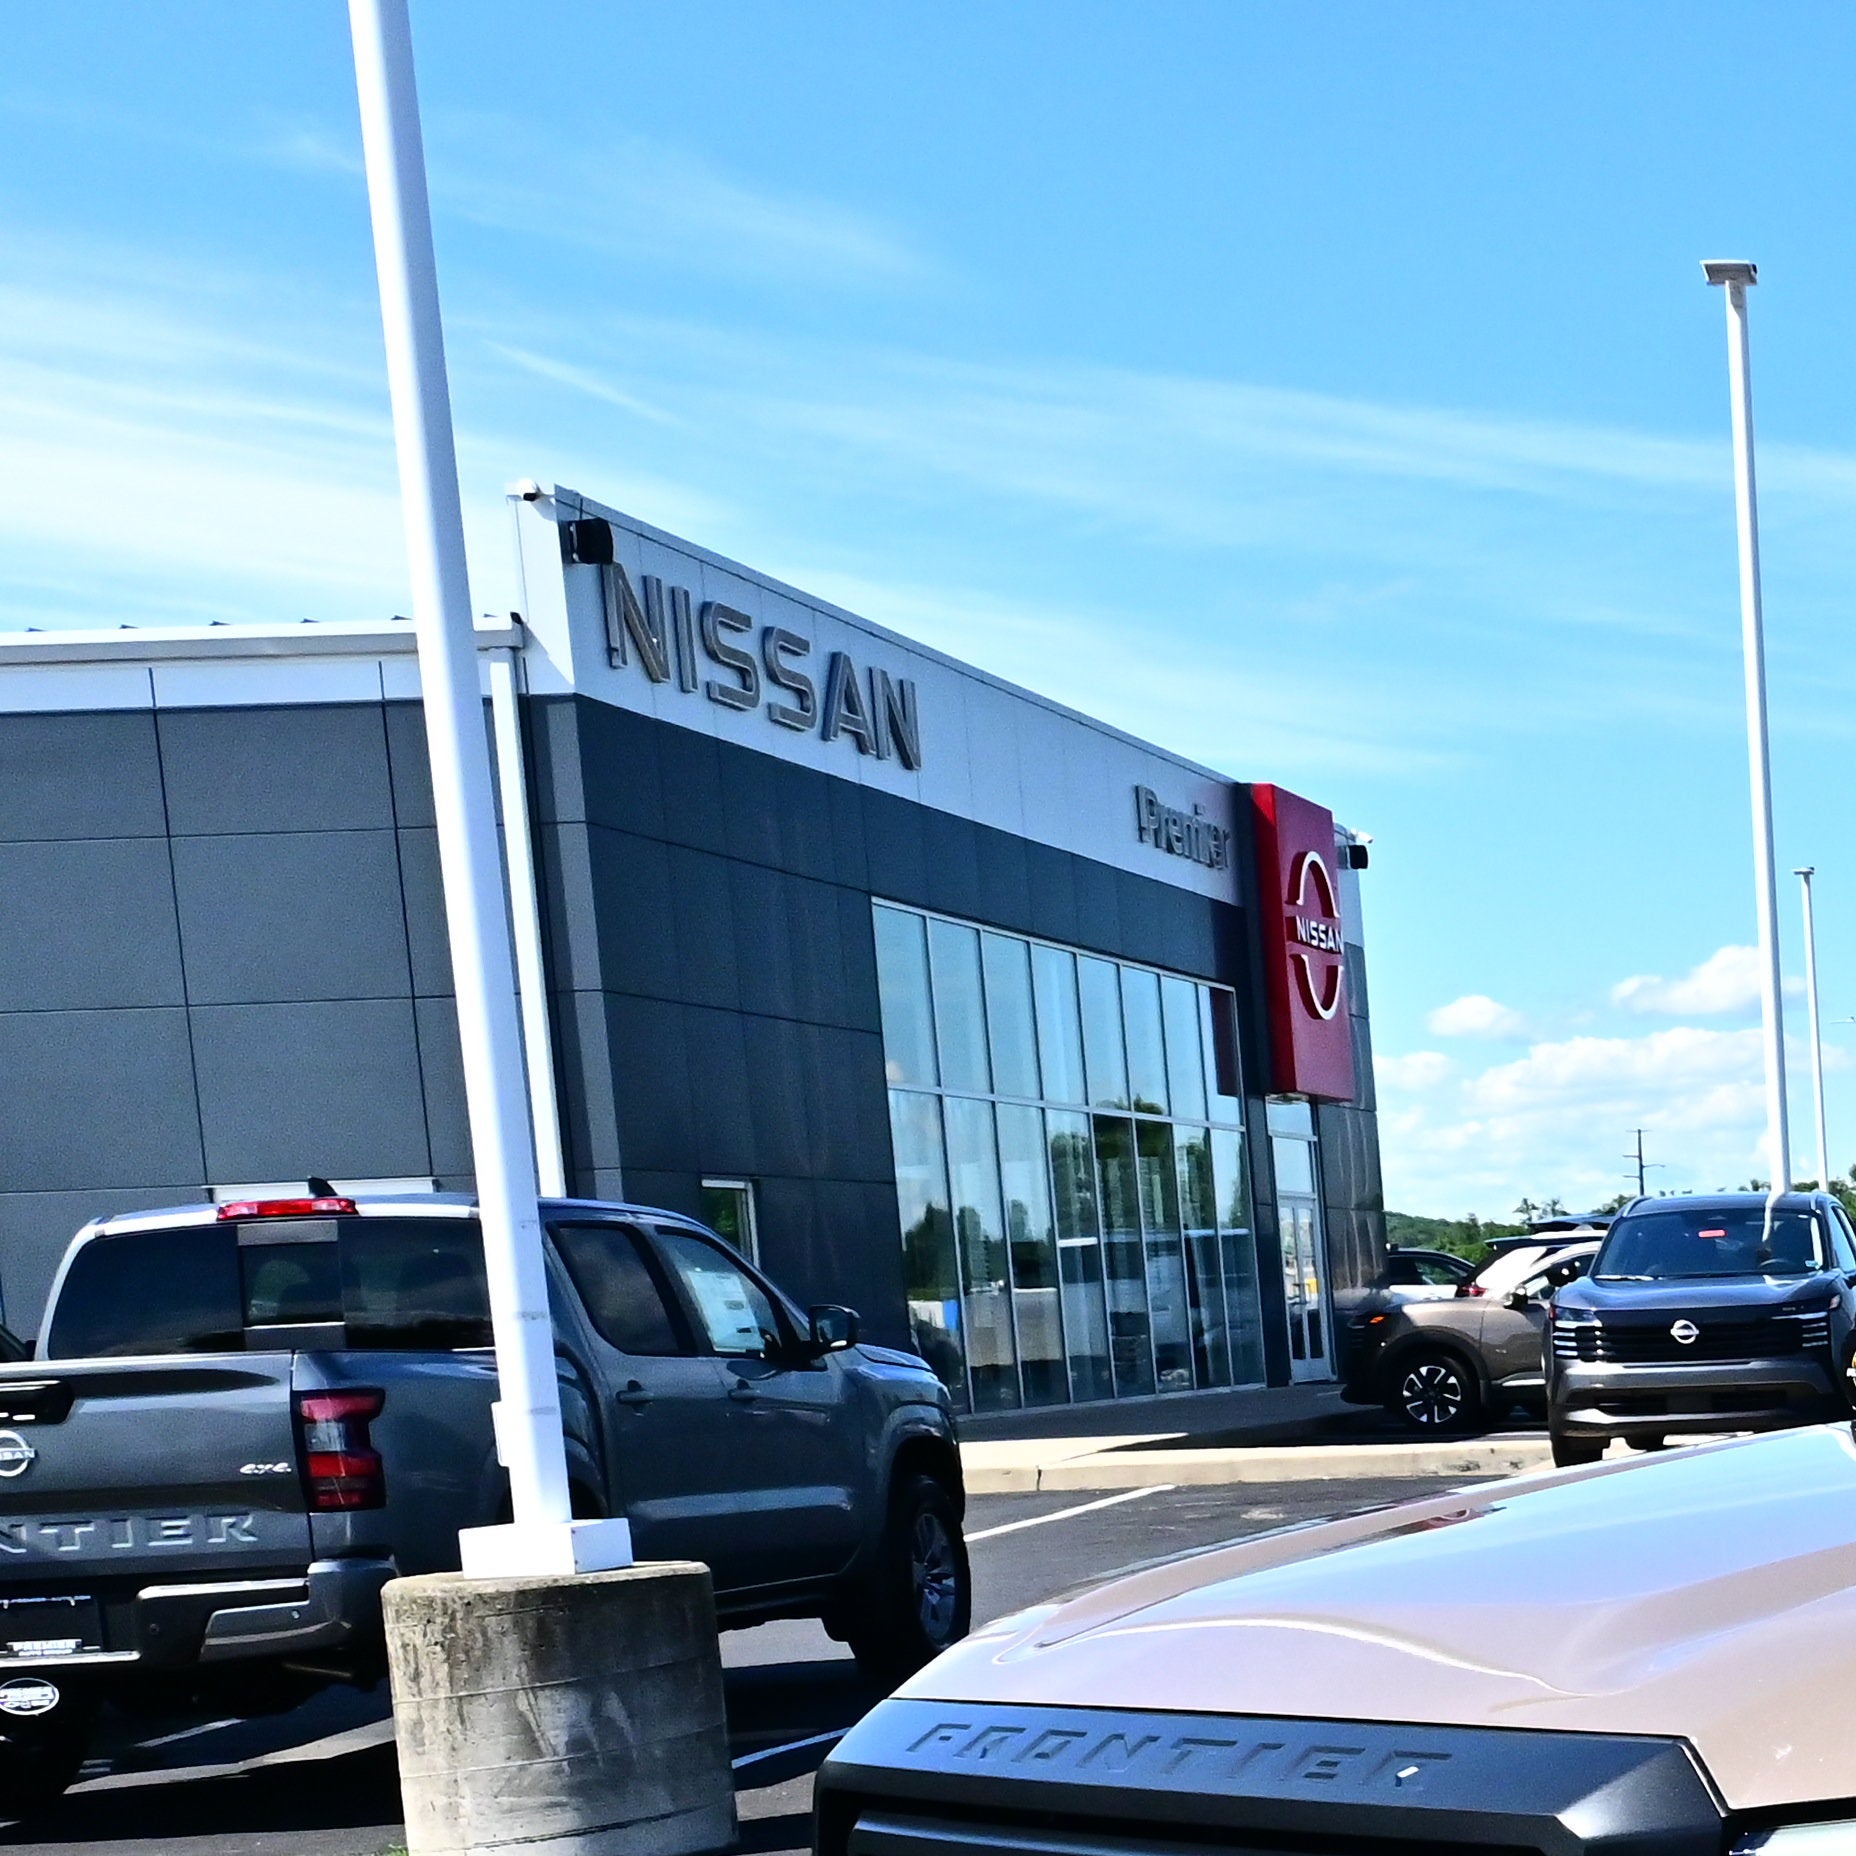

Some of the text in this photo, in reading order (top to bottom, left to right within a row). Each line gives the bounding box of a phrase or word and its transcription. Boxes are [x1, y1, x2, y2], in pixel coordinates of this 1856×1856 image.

[602, 562, 921, 771] NISSAN
[1134, 785, 1231, 871] Premier
[1295, 915, 1344, 954] NISSAN
[905, 1722, 1453, 1792] FRONTIER
